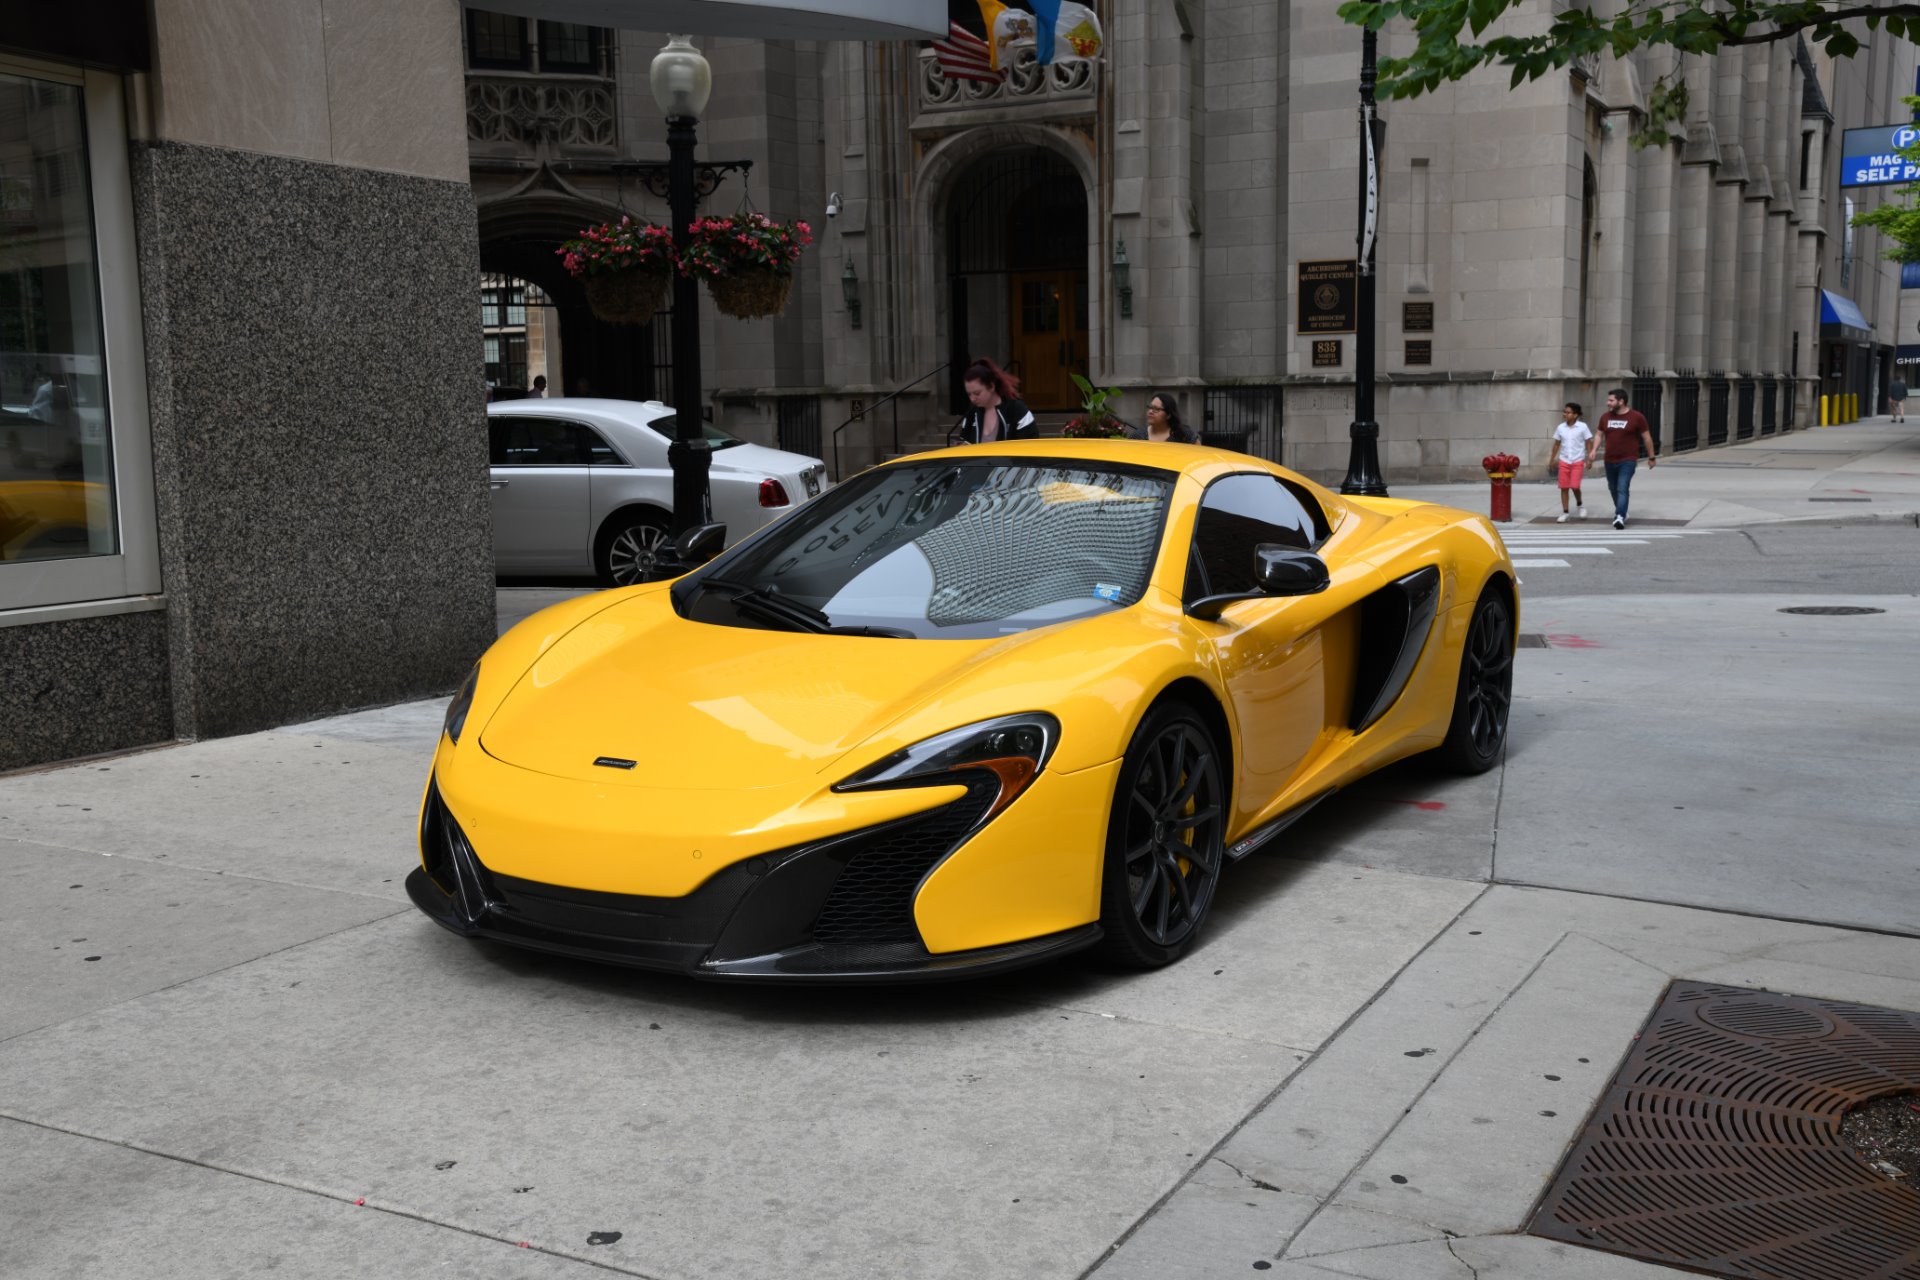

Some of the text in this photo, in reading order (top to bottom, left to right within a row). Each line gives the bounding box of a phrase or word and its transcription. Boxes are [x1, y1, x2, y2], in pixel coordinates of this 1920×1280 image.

[1870, 155, 1902, 166] MAG
[1856, 167, 1899, 182] SELF
[1328, 271, 1354, 279] CENTER
[1317, 341, 1337, 353] 835
